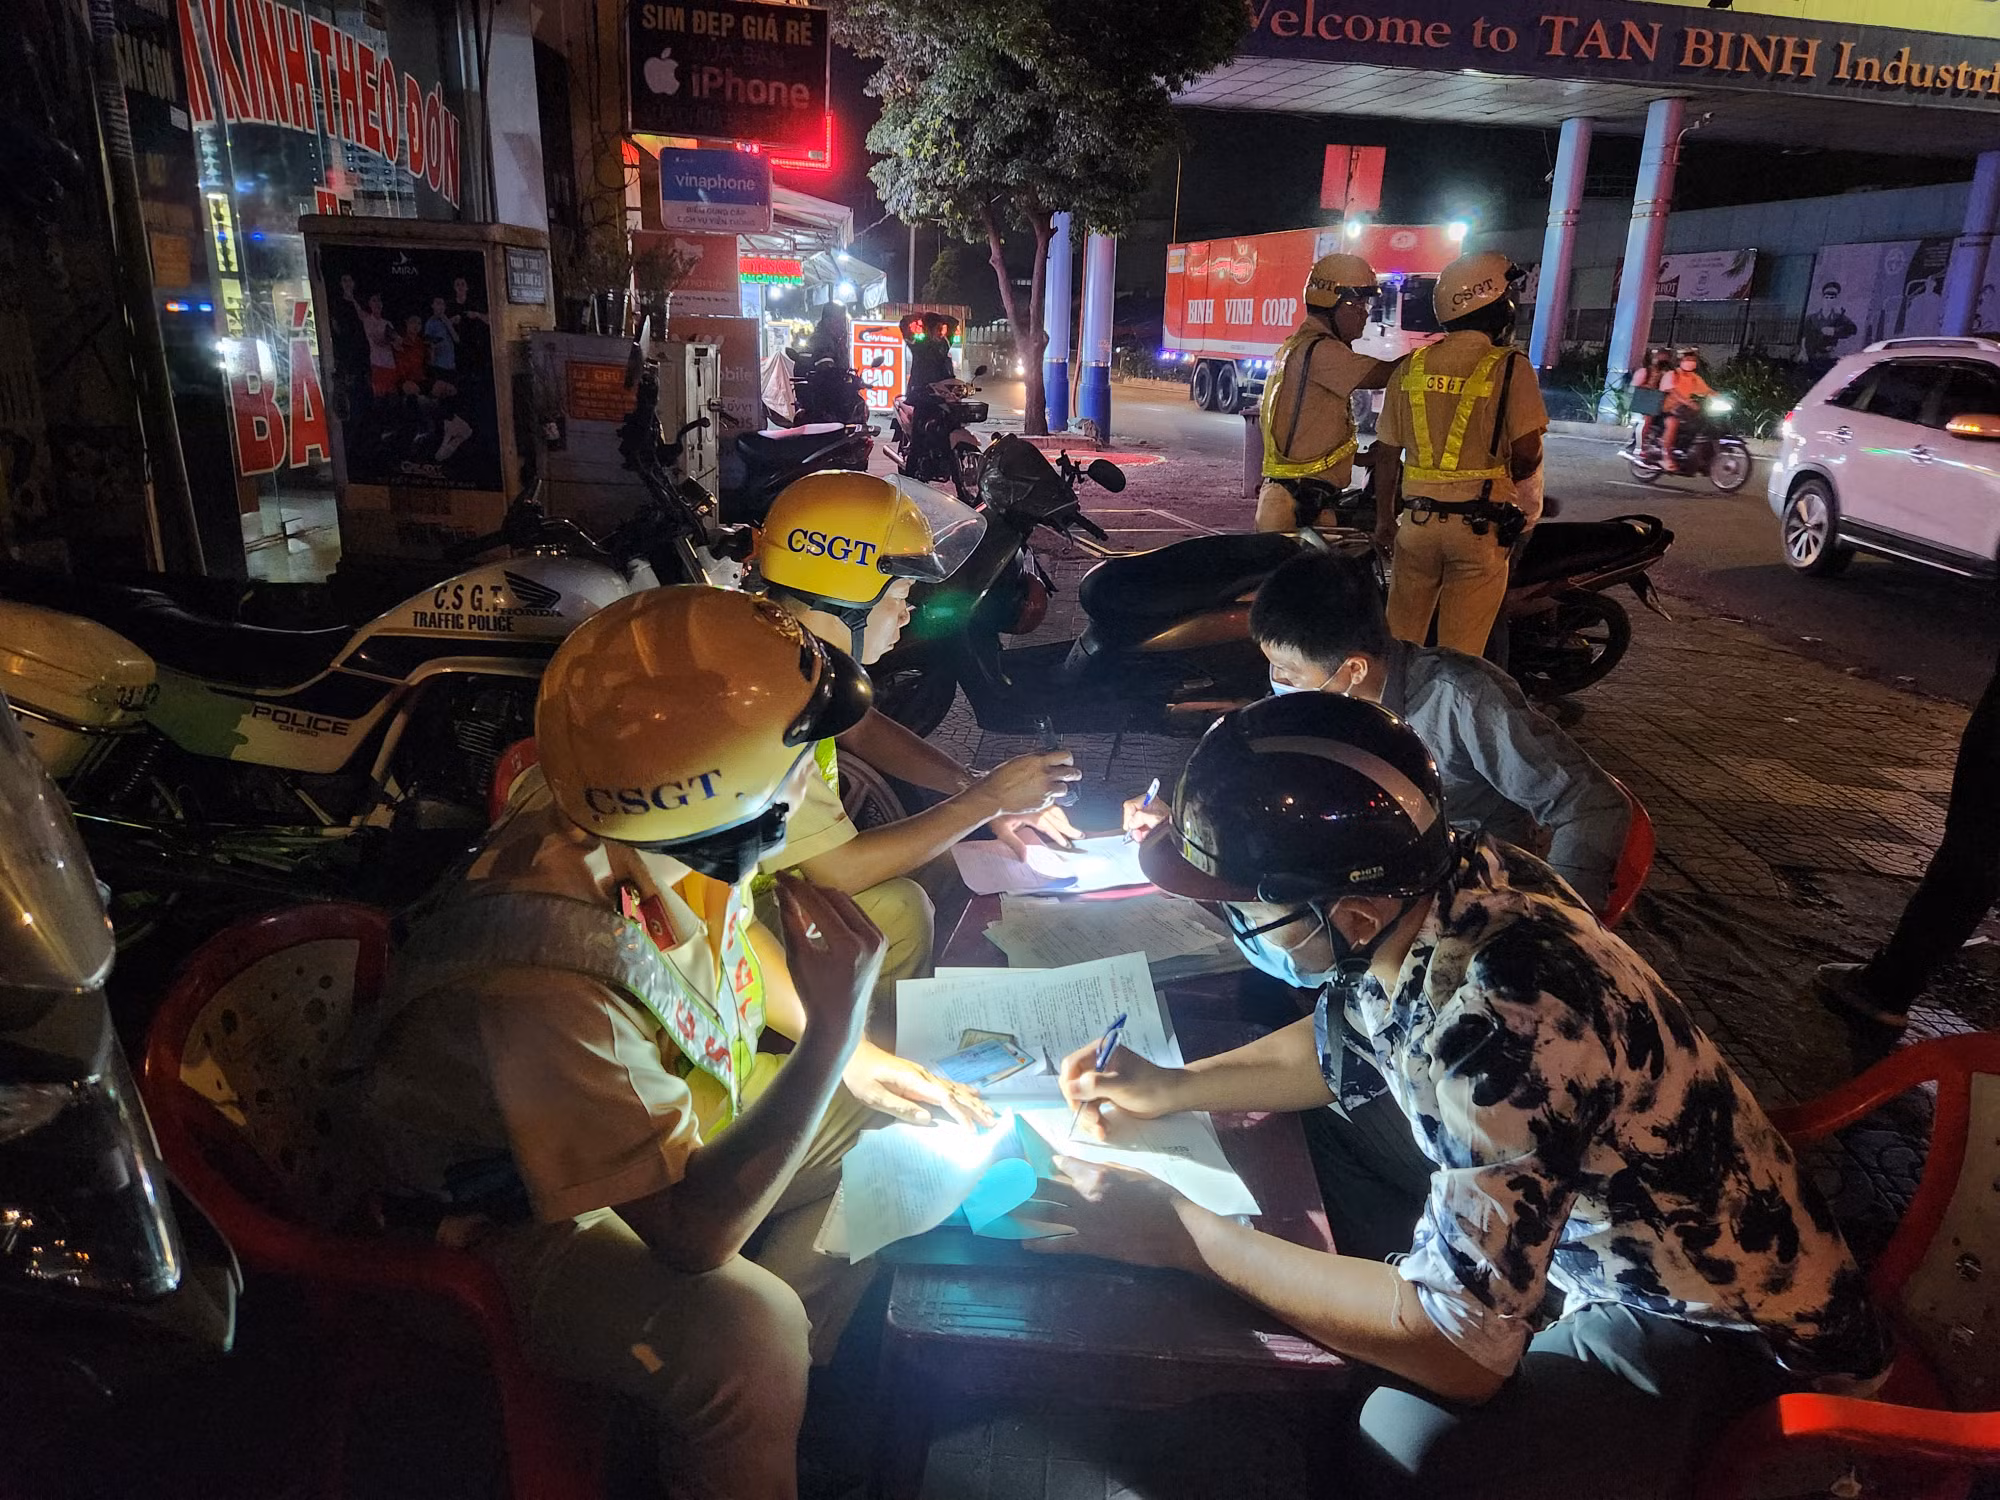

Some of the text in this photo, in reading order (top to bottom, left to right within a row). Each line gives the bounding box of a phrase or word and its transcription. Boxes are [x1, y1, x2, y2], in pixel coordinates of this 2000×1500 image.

[641, 3, 685, 32] SIM
[1472, 16, 1518, 52] to
[1540, 15, 1663, 61] TAN
[1680, 26, 1822, 77] BINH
[308, 14, 400, 165] THEO
[690, 64, 811, 109] iPhone
[674, 172, 756, 192] vinaphone
[391, 265, 419, 276] MIRA
[1452, 278, 1494, 306] CSGT
[1187, 297, 1298, 327] BINH VINH CORP
[861, 368, 895, 388] CAO
[865, 389, 888, 408] SU
[788, 527, 876, 566] CSGT
[413, 611, 515, 633] TRAFFIC POLICE
[500, 607, 564, 618] HONDA
[252, 705, 350, 737] POLICE
[584, 769, 722, 816] CSGT
